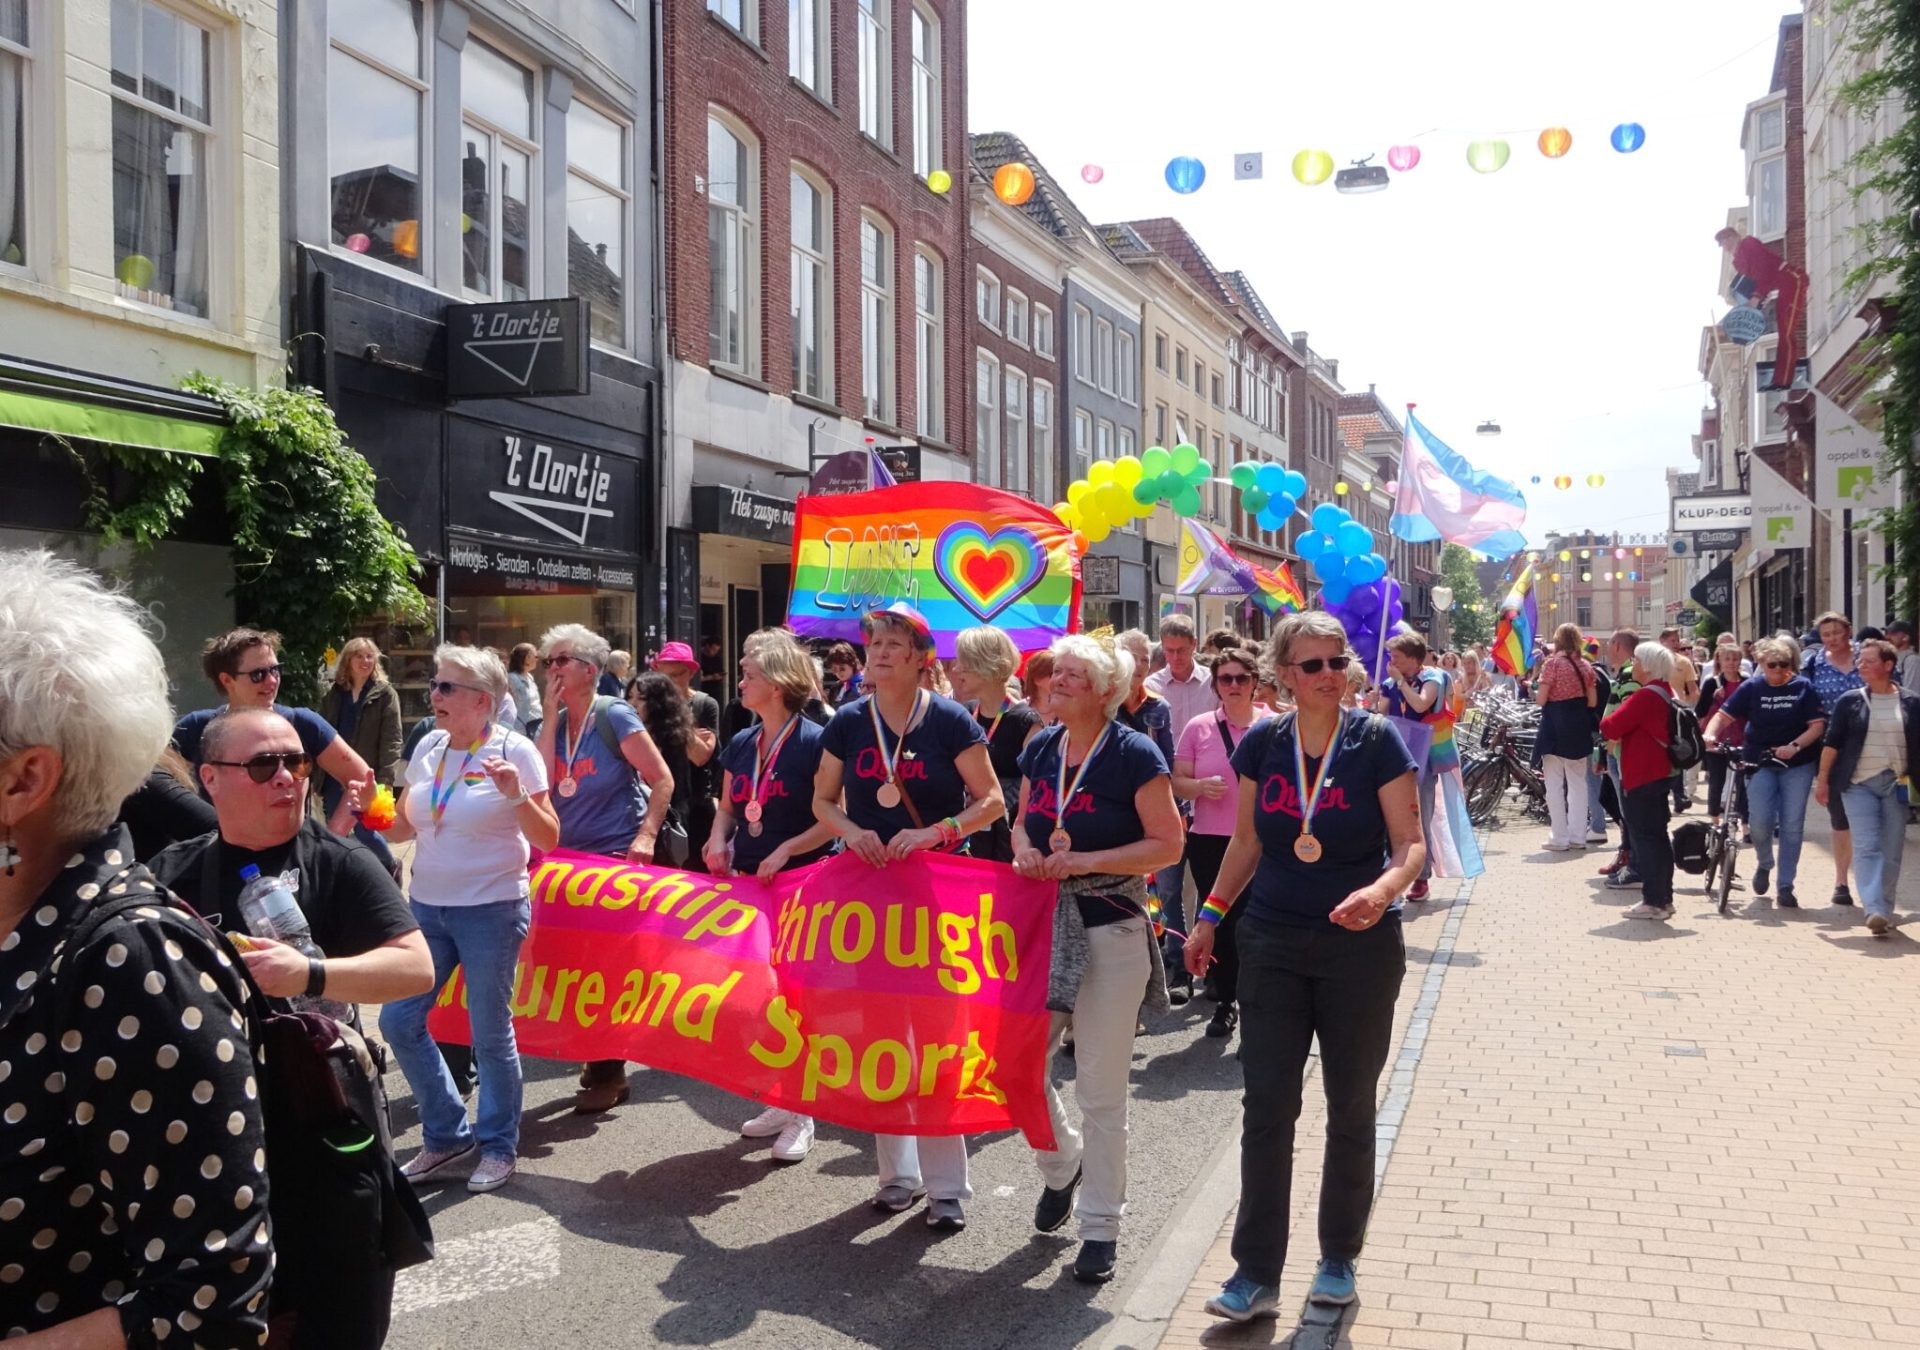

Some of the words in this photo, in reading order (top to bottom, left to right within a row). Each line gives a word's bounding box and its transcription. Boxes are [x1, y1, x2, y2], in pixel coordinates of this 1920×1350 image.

[1243, 161, 1253, 172] G
[471, 313, 484, 338] 't
[489, 309, 560, 338] Oortje
[505, 436, 523, 487] 't
[528, 445, 611, 503] Oortje
[730, 488, 753, 517] Het
[753, 503, 780, 530] zusje
[782, 509, 797, 526] va
[450, 546, 489, 574] Horloges
[496, 552, 530, 575] Sieraden
[536, 558, 571, 579] Oorbellen
[571, 563, 592, 581] zetten
[597, 565, 634, 586] Accessoires
[1773, 702, 1793, 710] pride
[529, 861, 758, 941] ndship
[771, 886, 1019, 995] through
[611, 969, 744, 1043] and
